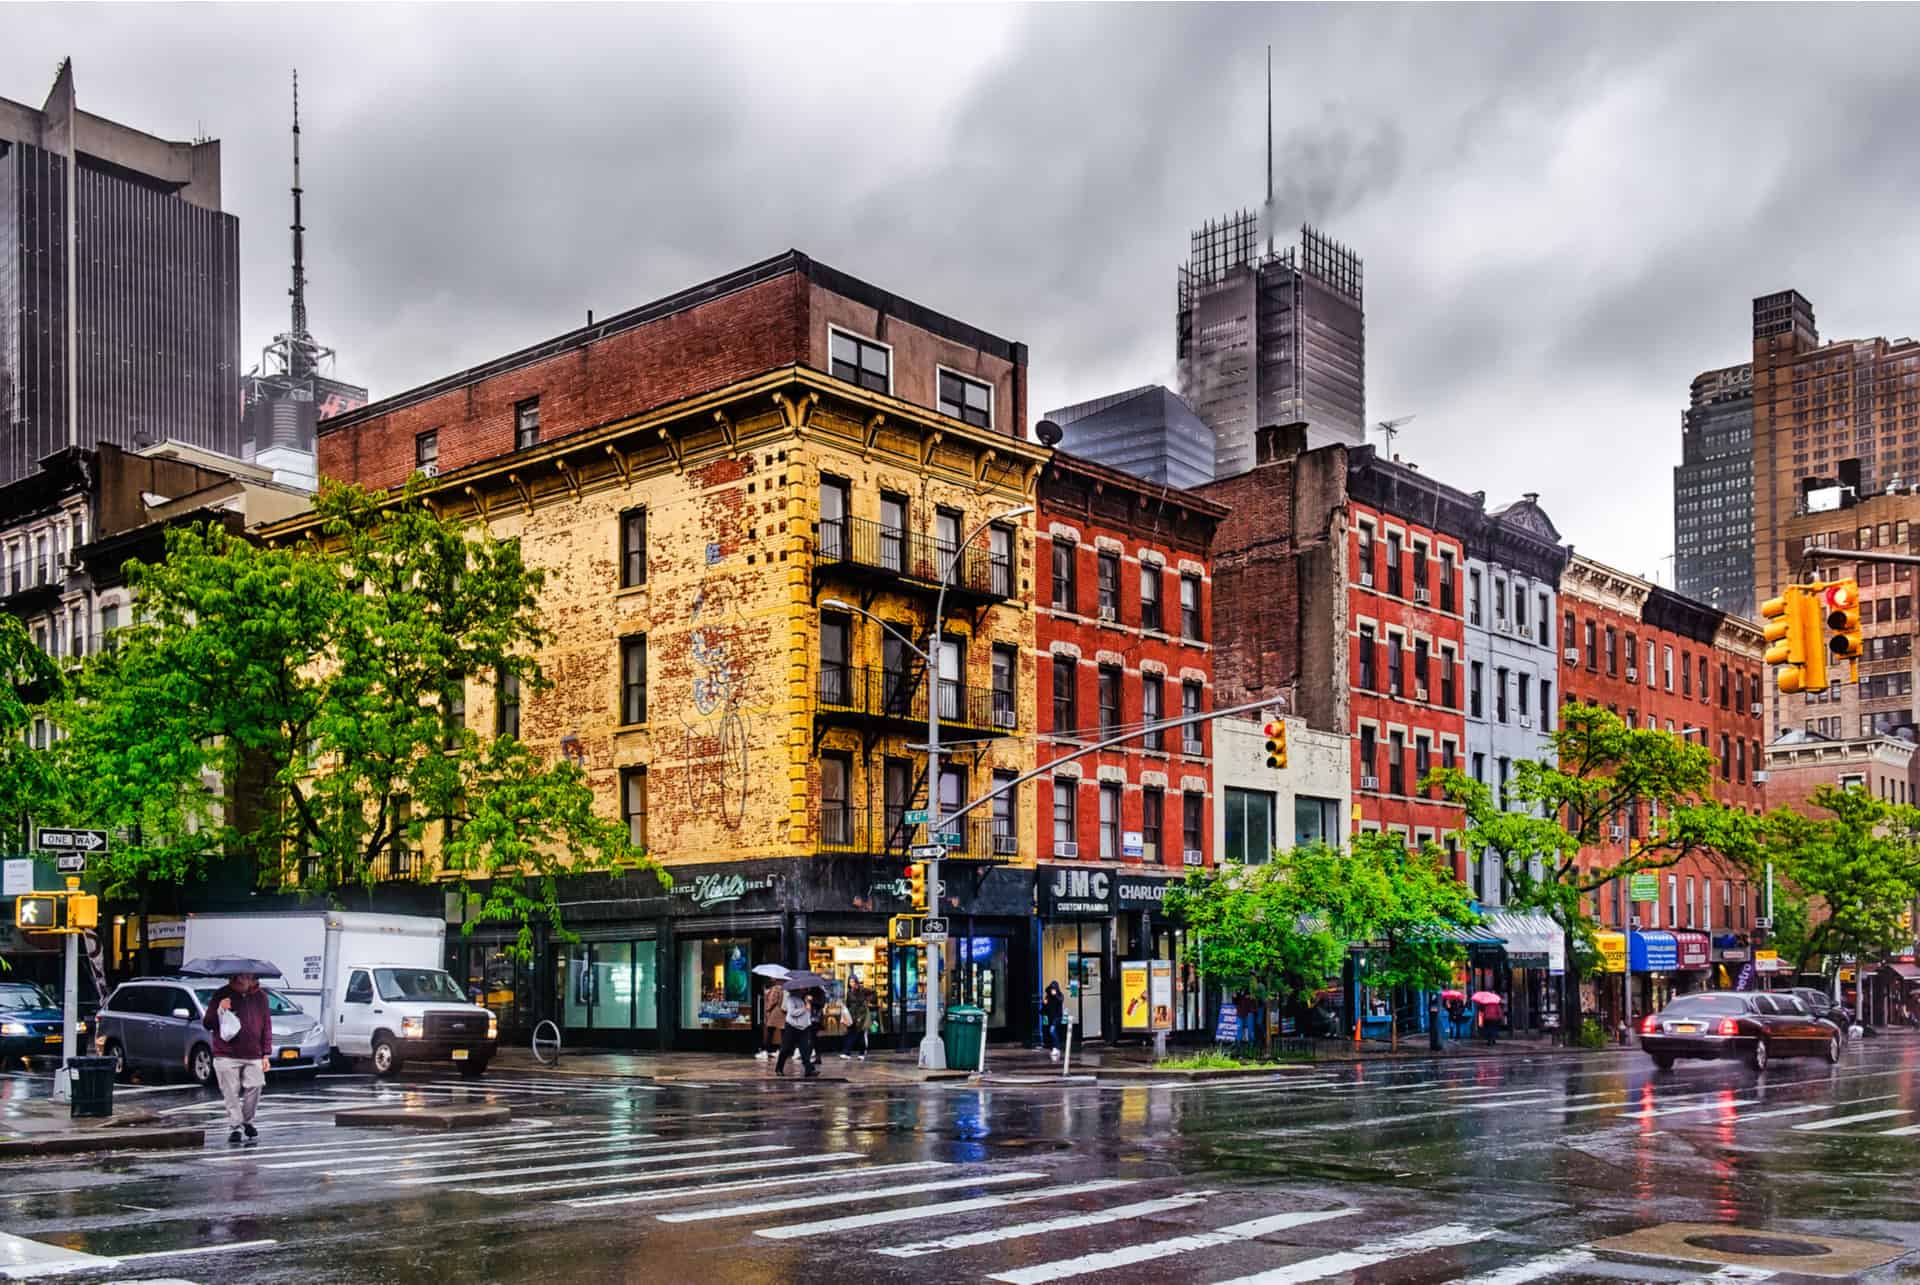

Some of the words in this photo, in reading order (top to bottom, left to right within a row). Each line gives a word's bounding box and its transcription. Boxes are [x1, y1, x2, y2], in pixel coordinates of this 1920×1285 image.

[47, 834, 69, 844] ONE
[77, 836, 97, 846] WAY
[691, 873, 745, 908] Kiehl's
[1053, 869, 1109, 899] JMC
[1057, 902, 1082, 912] CUSTOM
